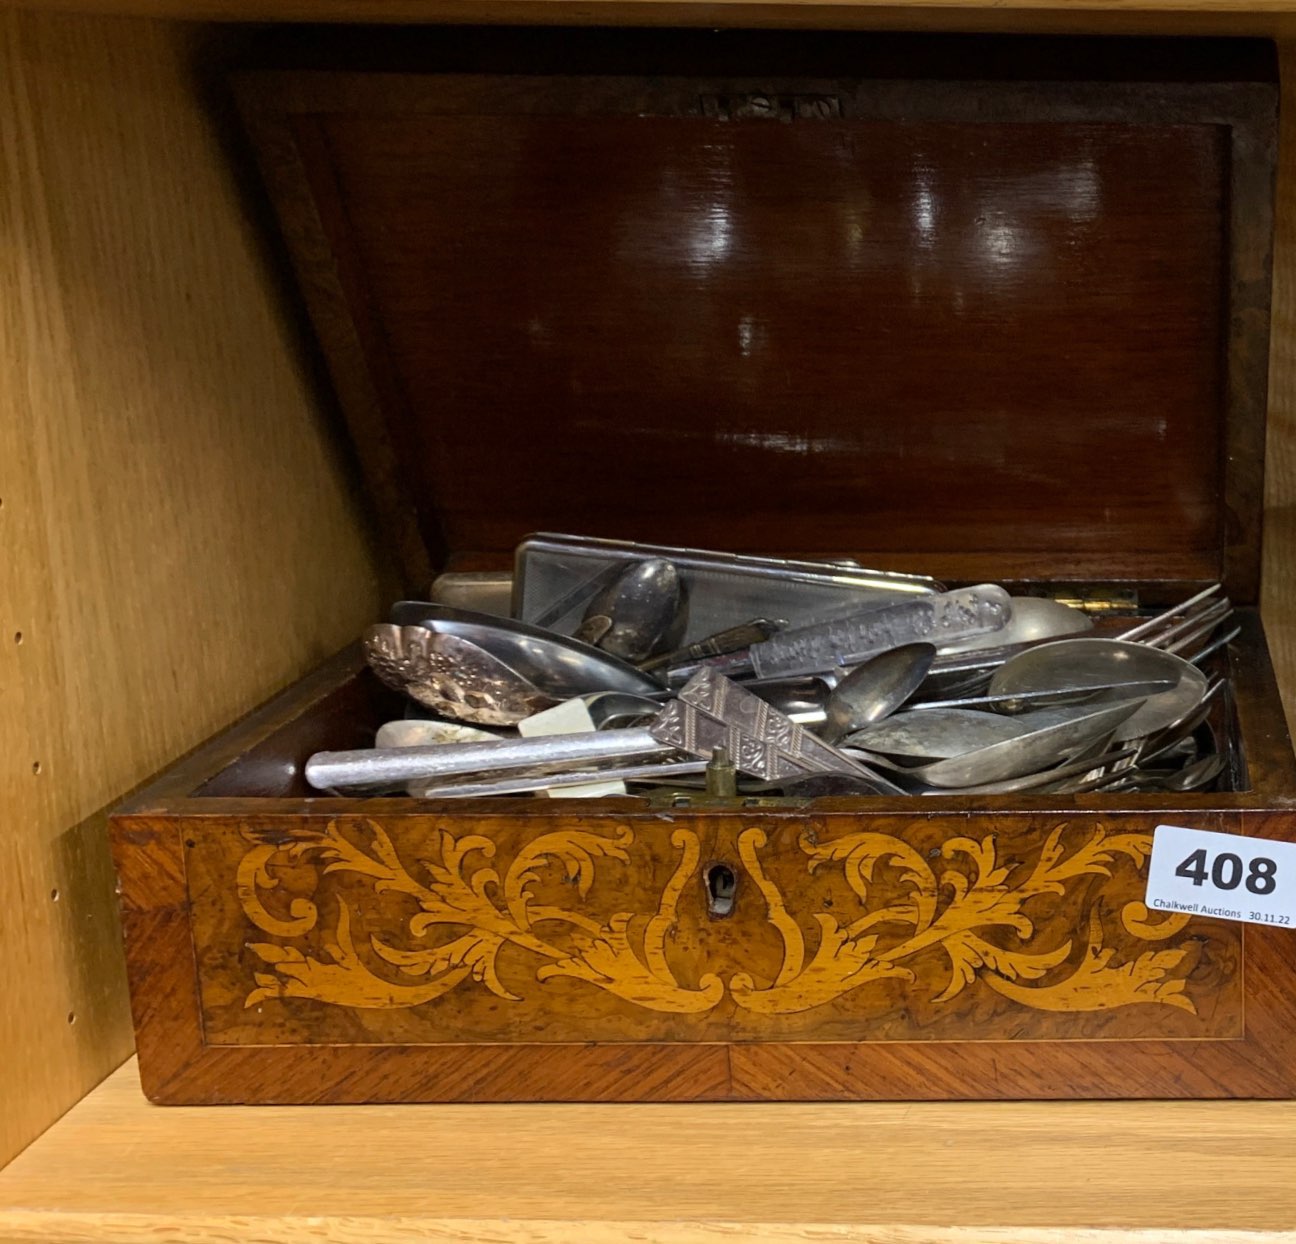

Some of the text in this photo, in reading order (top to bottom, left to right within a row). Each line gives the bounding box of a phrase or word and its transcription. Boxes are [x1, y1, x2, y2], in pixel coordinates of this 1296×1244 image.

[1175, 848, 1277, 895] 408
[1153, 898, 1290, 925] Chalkwell Auctions 30.11.22
